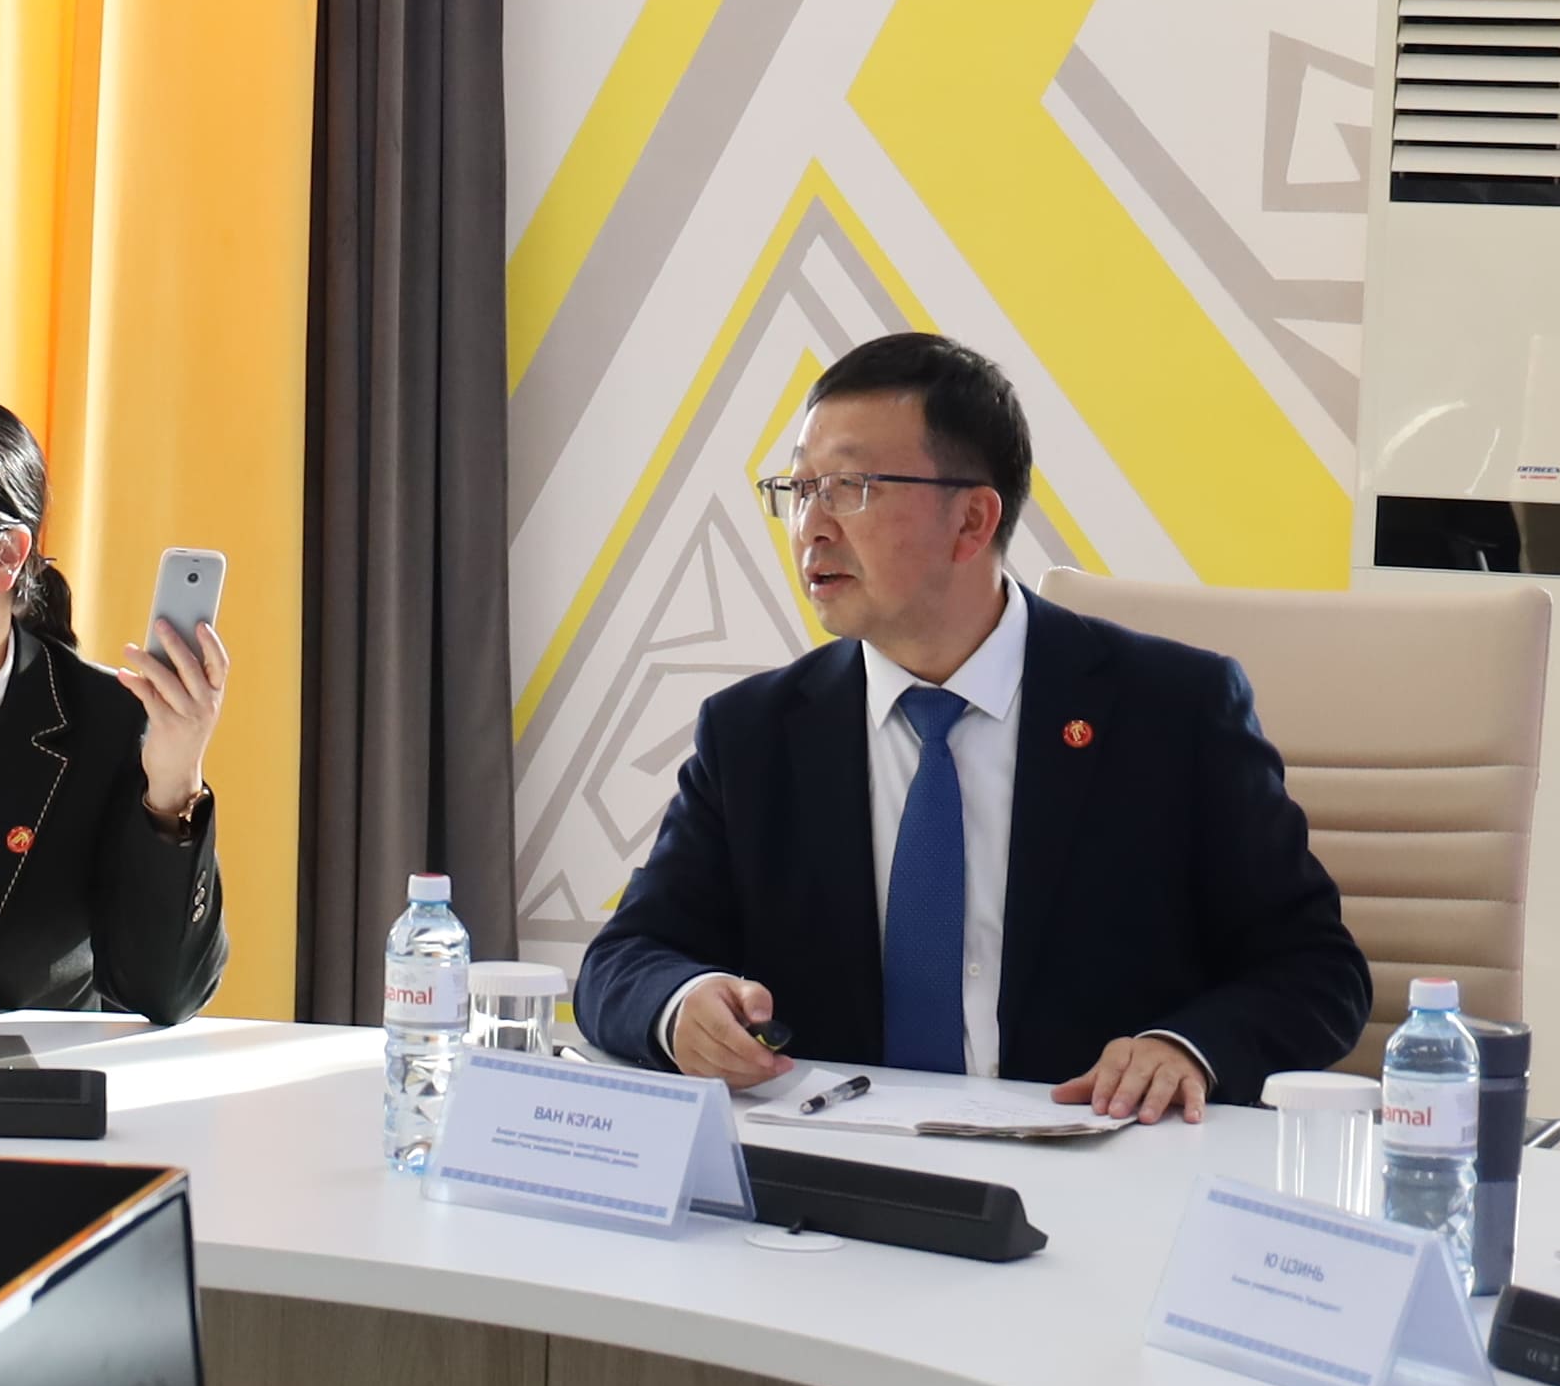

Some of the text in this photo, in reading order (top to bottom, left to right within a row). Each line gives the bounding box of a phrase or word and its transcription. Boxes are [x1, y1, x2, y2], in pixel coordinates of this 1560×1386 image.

[534, 1105, 613, 1132] ВАН КЭГАН
[1383, 1105, 1432, 1127] amal
[1264, 1251, 1325, 1282] Ю ЦЗИНЬ
